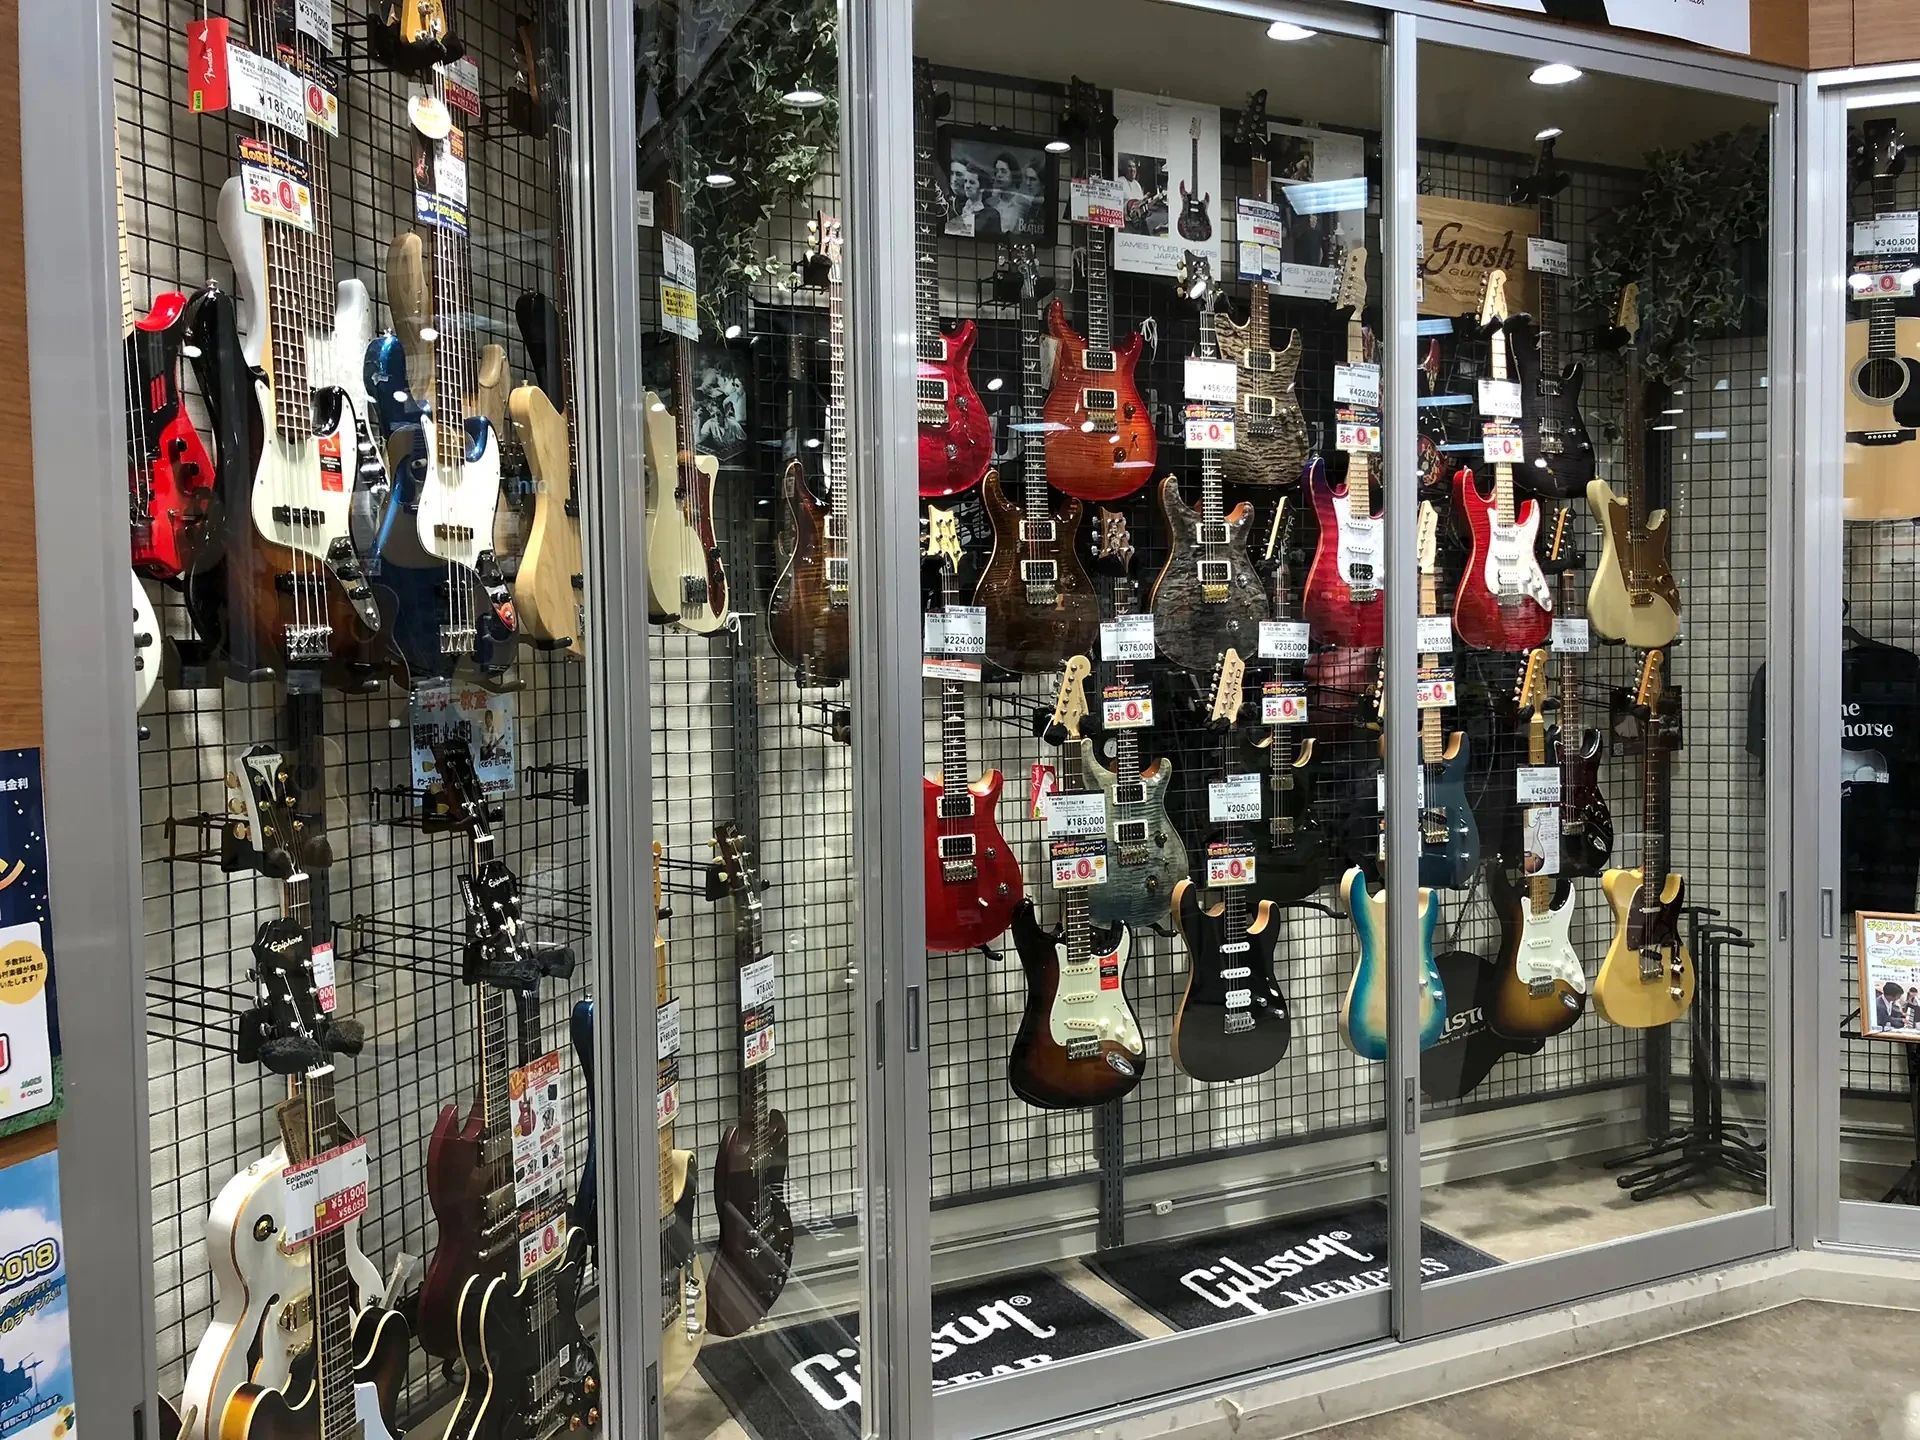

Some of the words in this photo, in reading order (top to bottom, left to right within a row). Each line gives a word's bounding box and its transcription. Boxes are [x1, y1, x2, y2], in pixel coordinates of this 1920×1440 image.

[299, 3, 328, 31] ¥370,000
[203, 47, 216, 85] Fender
[259, 93, 305, 126] ¥185,000
[250, 186, 271, 205] 36
[1119, 241, 1149, 250] JAMES
[1152, 243, 1179, 253] TYLER
[1424, 222, 1516, 276] Grosh
[1875, 238, 1917, 247] ¥340,800
[1349, 387, 1377, 400] ¥422,000
[1190, 432, 1203, 441] 36
[1340, 433, 1352, 443] 36
[944, 636, 984, 645] ¥224,000
[1119, 643, 1154, 652] ¥376,000
[1107, 712, 1120, 722] 36
[1265, 708, 1277, 717] 36
[1531, 786, 1559, 795] ¥454,000
[1227, 803, 1260, 812] ¥205,000
[1067, 816, 1105, 826] ¥185,000
[1056, 871, 1072, 880] 36
[1211, 870, 1225, 880] 36
[270, 934, 304, 953] Epiphone
[746, 1046, 757, 1059] 36
[27, 1087, 43, 1097] Orico
[284, 1166, 297, 1176] SALE
[300, 1160, 312, 1170] SALE
[285, 1168, 319, 1185] Epiphone
[291, 1178, 314, 1192] CASINO
[331, 1183, 366, 1210] ¥51,900
[338, 1197, 365, 1218] ¥56,052
[523, 1248, 538, 1267] 36
[1180, 1234, 1375, 1315] Gibson
